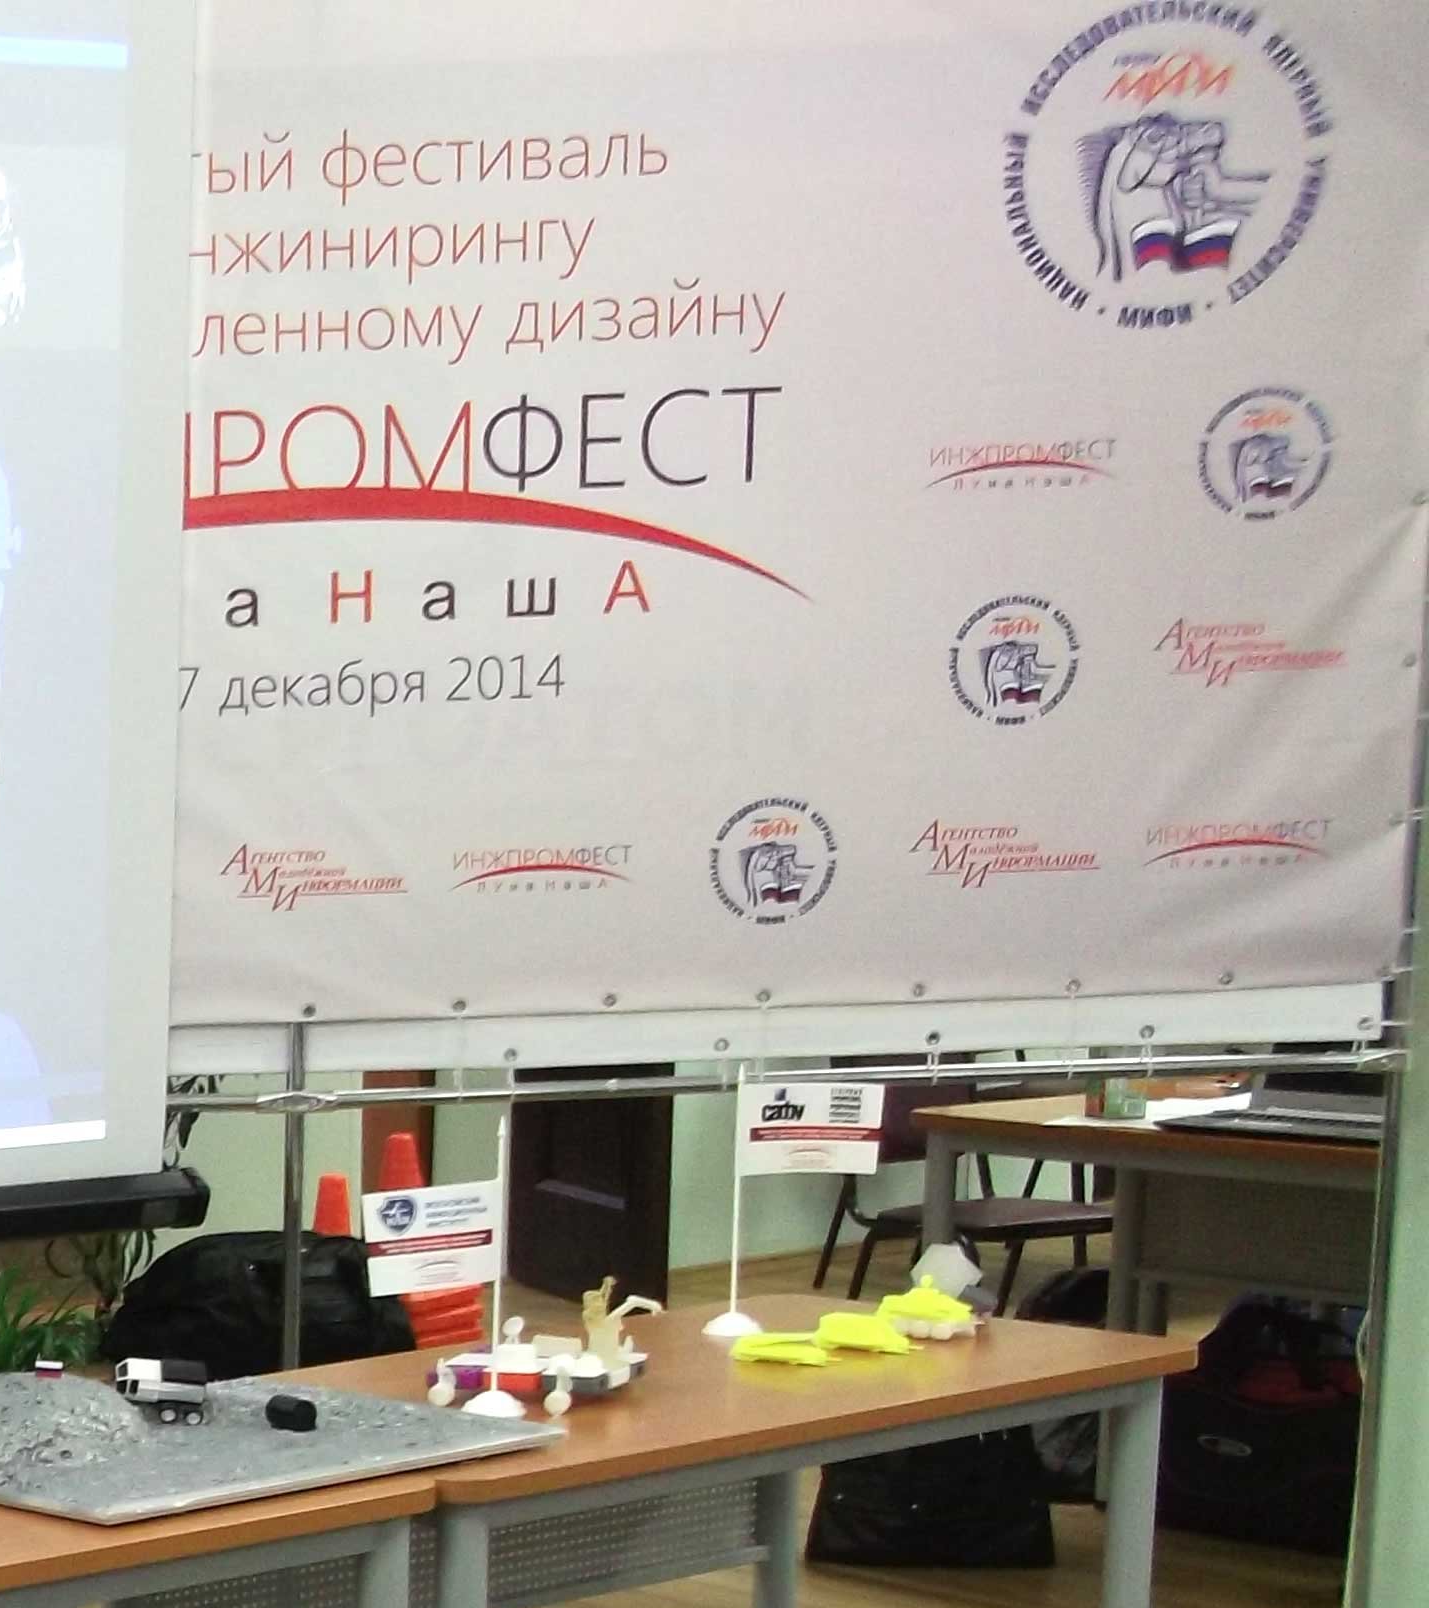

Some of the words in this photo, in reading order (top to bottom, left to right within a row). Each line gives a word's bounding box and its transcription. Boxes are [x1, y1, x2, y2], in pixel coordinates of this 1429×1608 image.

[321, 128, 668, 206] фестиваль
[191, 302, 483, 366] ленному
[505, 276, 787, 354] дизайну
[183, 386, 783, 497] РОМФЕСТ
[218, 659, 426, 717] декабря
[445, 653, 566, 702] 2014
